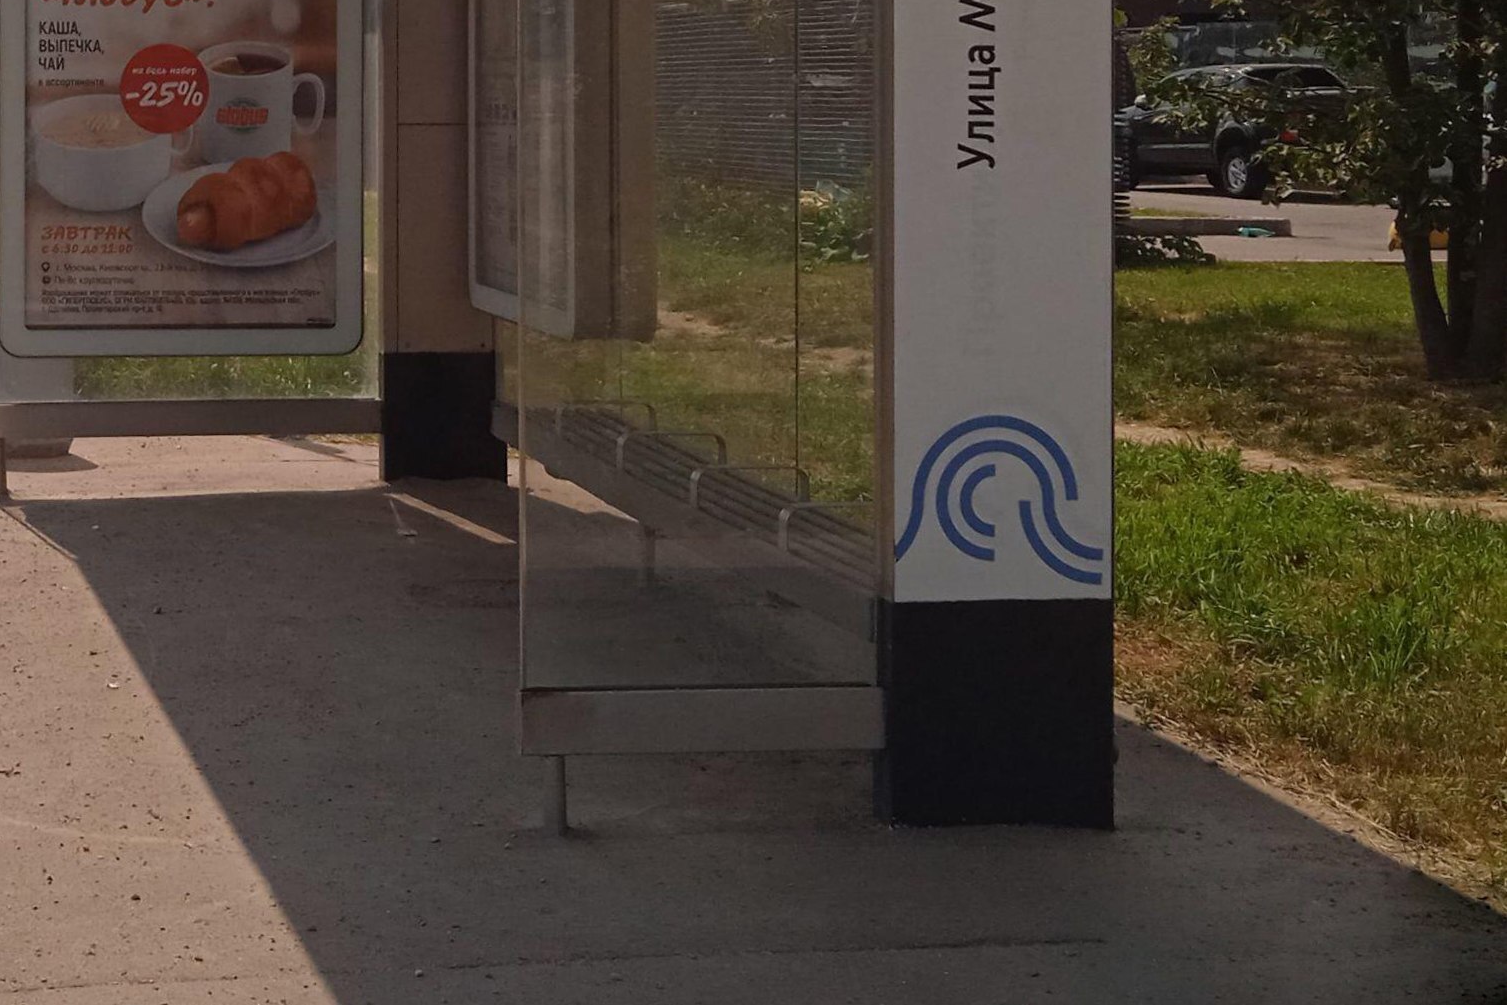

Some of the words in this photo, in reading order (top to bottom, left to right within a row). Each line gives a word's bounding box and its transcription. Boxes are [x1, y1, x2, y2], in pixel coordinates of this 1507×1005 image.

[39, 21, 82, 37] КАША,
[39, 39, 106, 55] ВЫПЕЧКА,
[39, 54, 65, 71] ЧАЙ
[125, 81, 204, 107] -25%
[957, 44, 1001, 170] Улица
[41, 225, 132, 241] ЗАВТРАК
